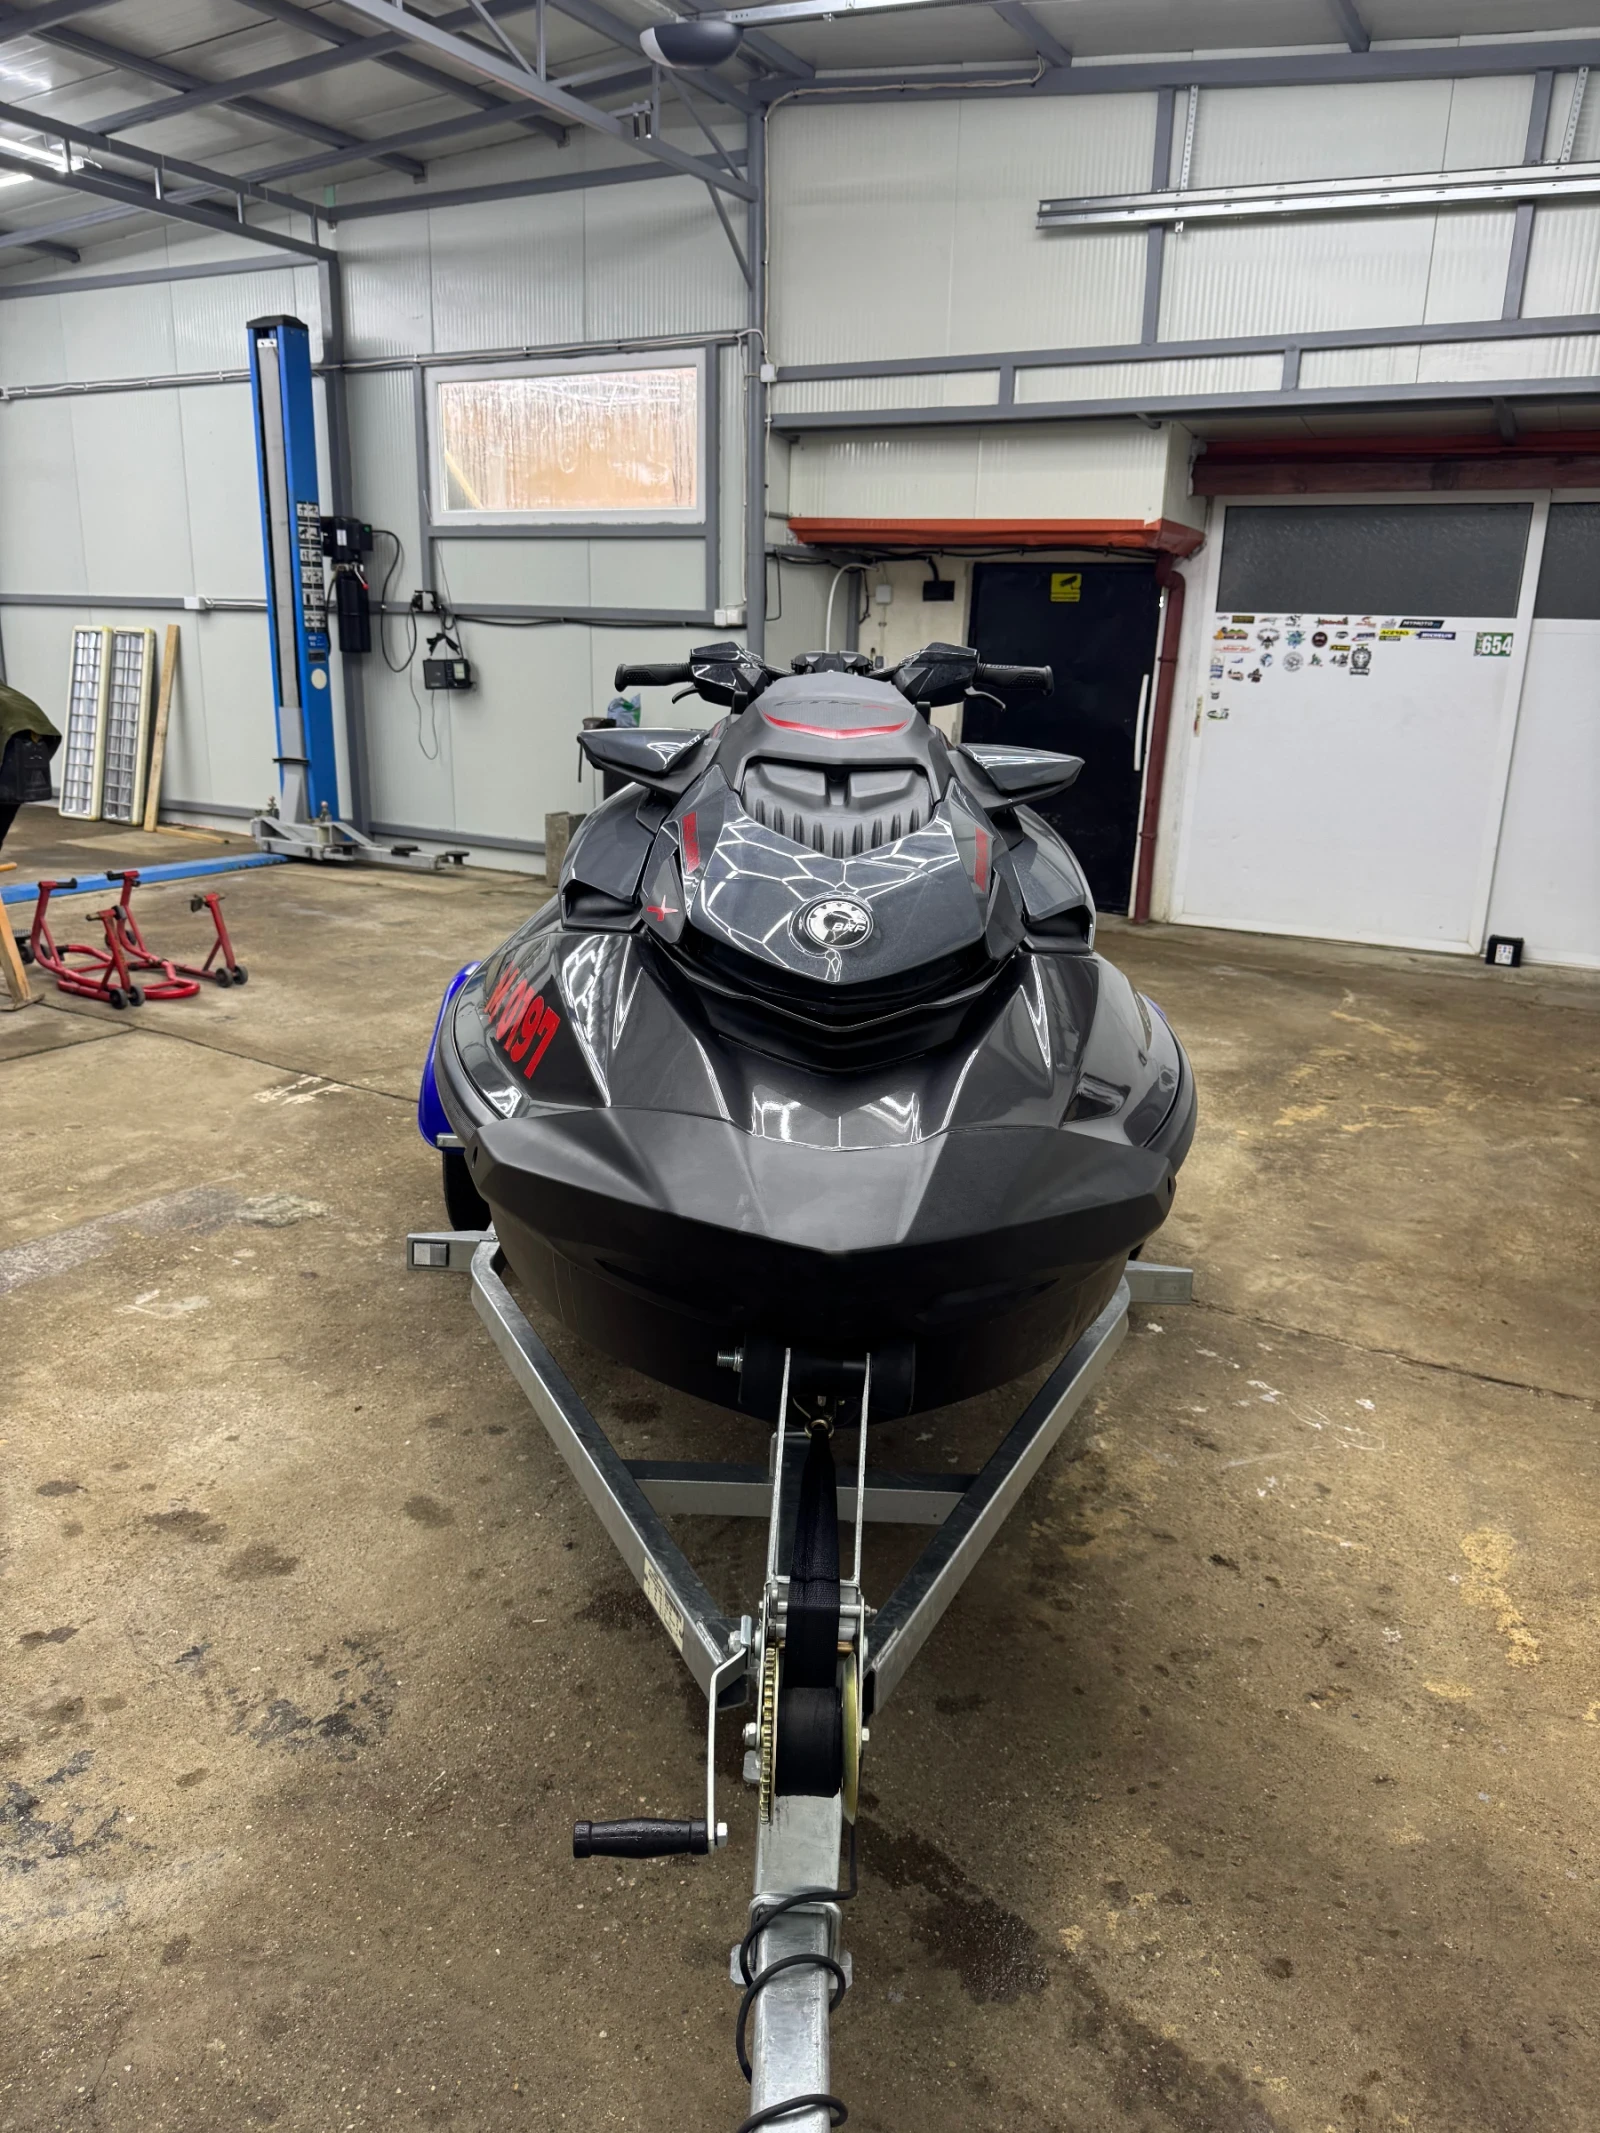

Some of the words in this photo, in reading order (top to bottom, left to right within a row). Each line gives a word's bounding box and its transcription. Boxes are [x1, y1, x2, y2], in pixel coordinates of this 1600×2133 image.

[1482, 635, 1512, 654] 654
[832, 922, 866, 933] BRP
[496, 977, 561, 1079] 0197
